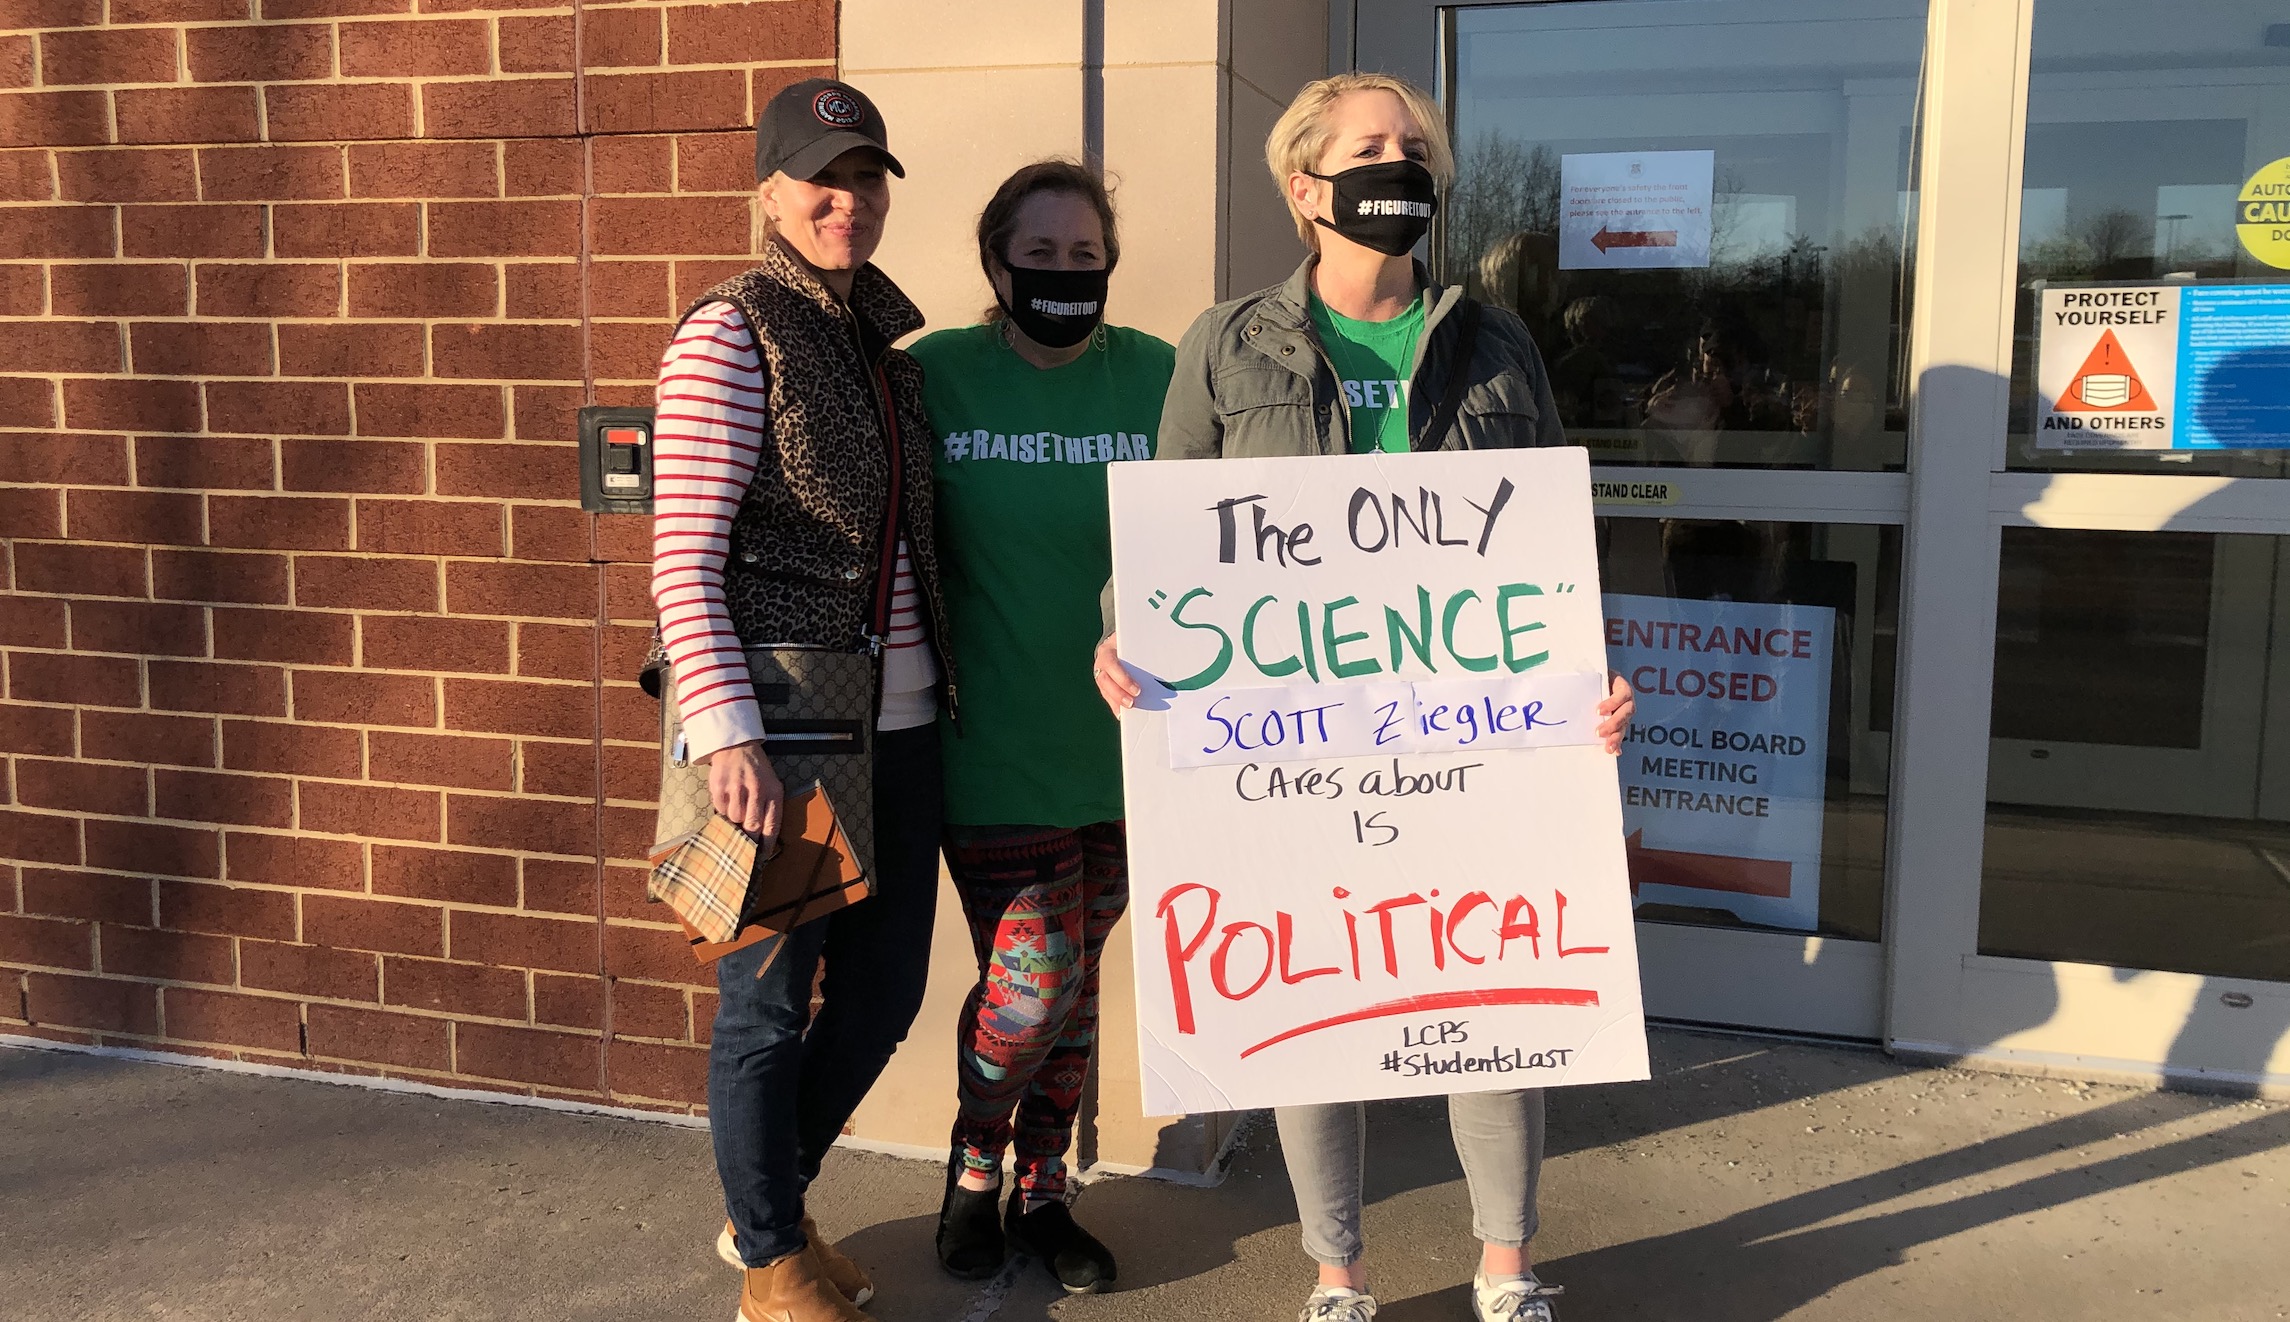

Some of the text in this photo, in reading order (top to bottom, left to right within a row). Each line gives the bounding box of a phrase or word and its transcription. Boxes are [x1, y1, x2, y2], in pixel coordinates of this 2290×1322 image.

[828, 100, 851, 114] MCM
[1570, 183, 1688, 194] For everyone's safety the front
[1357, 200, 1431, 219] #FIGUREITOUT
[1569, 210, 1594, 218] please
[1030, 298, 1098, 316] #FIGUREITOUT
[2063, 291, 2160, 307] PROTECT
[2055, 310, 2167, 326] YOURSELF
[2043, 416, 2166, 430] AND OTHERS
[944, 429, 1151, 464] #RAISETHEBAR
[1592, 483, 1668, 499] STAND CLEAR
[1205, 476, 1515, 568] The ONLY
[1147, 583, 1576, 691] "SCIENCE"
[1605, 618, 1812, 659] ENTRANCE
[1631, 665, 1777, 702] CLOSED
[1203, 696, 1345, 754] SCOTT
[1622, 723, 1806, 756] HOOL BOARD
[1641, 755, 1758, 785] MEETING
[1626, 785, 1770, 818] ENTRANCE
[1353, 810, 1399, 846] IS
[1403, 1020, 1470, 1048] LCPS
